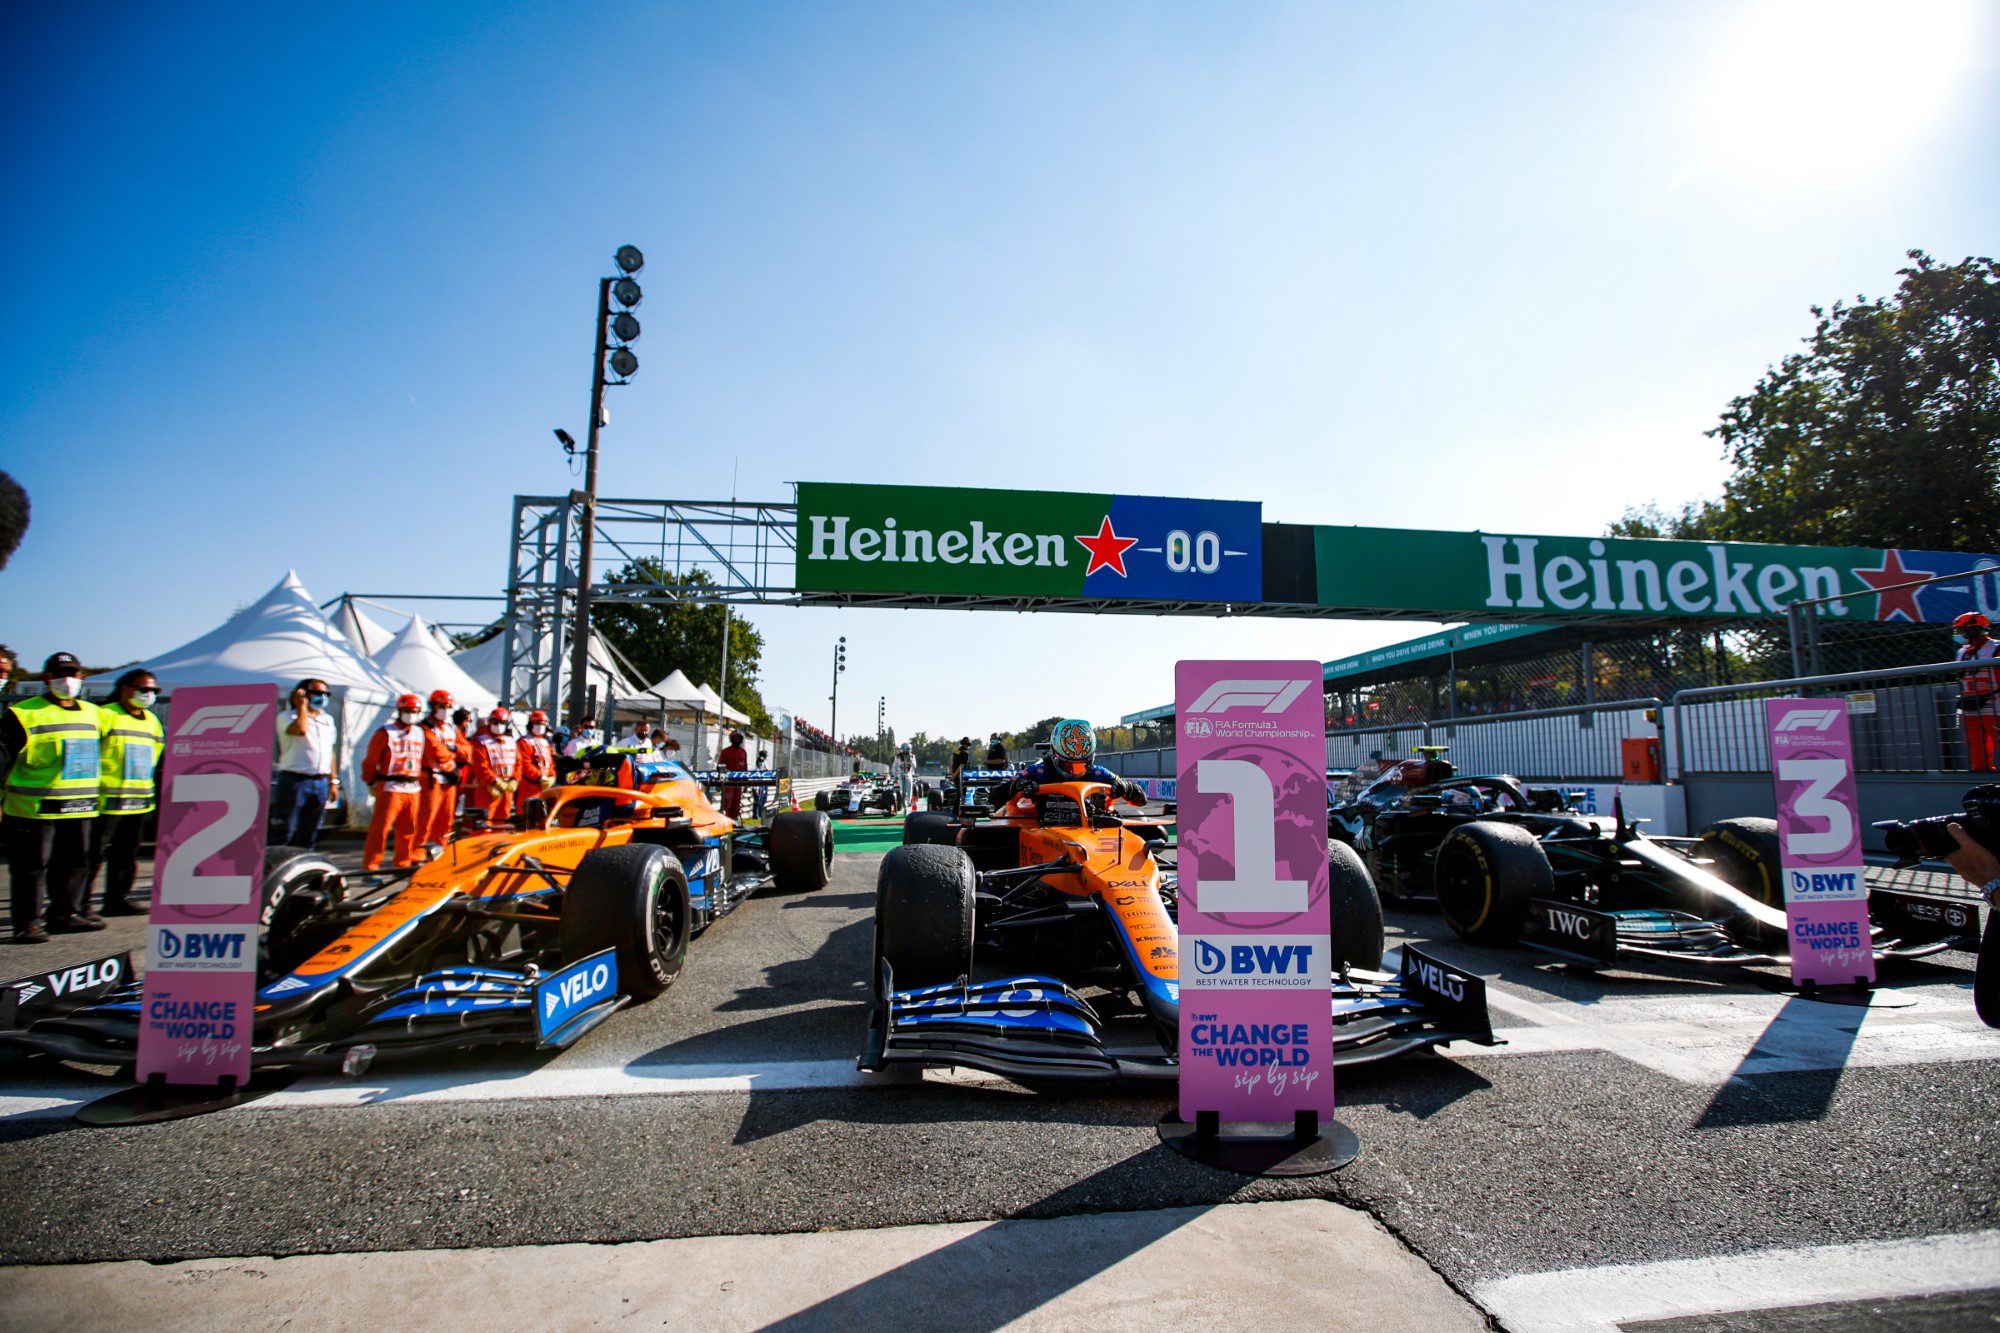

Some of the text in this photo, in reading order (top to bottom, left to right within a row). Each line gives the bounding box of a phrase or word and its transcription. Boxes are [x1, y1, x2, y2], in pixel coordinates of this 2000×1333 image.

[807, 515, 1068, 567] Heineken
[1165, 530, 1220, 574] 0.0
[1480, 535, 1849, 618] Heineken
[1464, 629, 1482, 640] WHEN
[1483, 625, 1498, 635] YOU
[1184, 680, 1313, 714] F1
[1186, 721, 1212, 734] FIA
[1215, 721, 1278, 729] FIA Formula 1
[1215, 729, 1243, 738] World
[1778, 759, 1853, 855] 3
[160, 773, 260, 905] 2
[1197, 760, 1308, 912] 1
[1811, 873, 1856, 892] BWT
[1907, 903, 1941, 917] INEOS
[1548, 909, 1591, 940] IWC
[1795, 921, 1859, 937] CHANGE
[183, 933, 246, 959] BWT
[1809, 936, 1860, 950] WORLD
[1231, 945, 1313, 974] BWT
[48, 957, 121, 997] VELO
[560, 963, 608, 1009] VELO
[1252, 978, 1312, 986] TECHNOLOGY
[1418, 958, 1464, 1002] VELO
[151, 1001, 237, 1021] CHANGE
[165, 1022, 235, 1040] WORLD
[1191, 1024, 1309, 1045] CHANGE
[1192, 1048, 1310, 1067] THE WORLD
[1234, 1058, 1319, 1097] sip by sip
